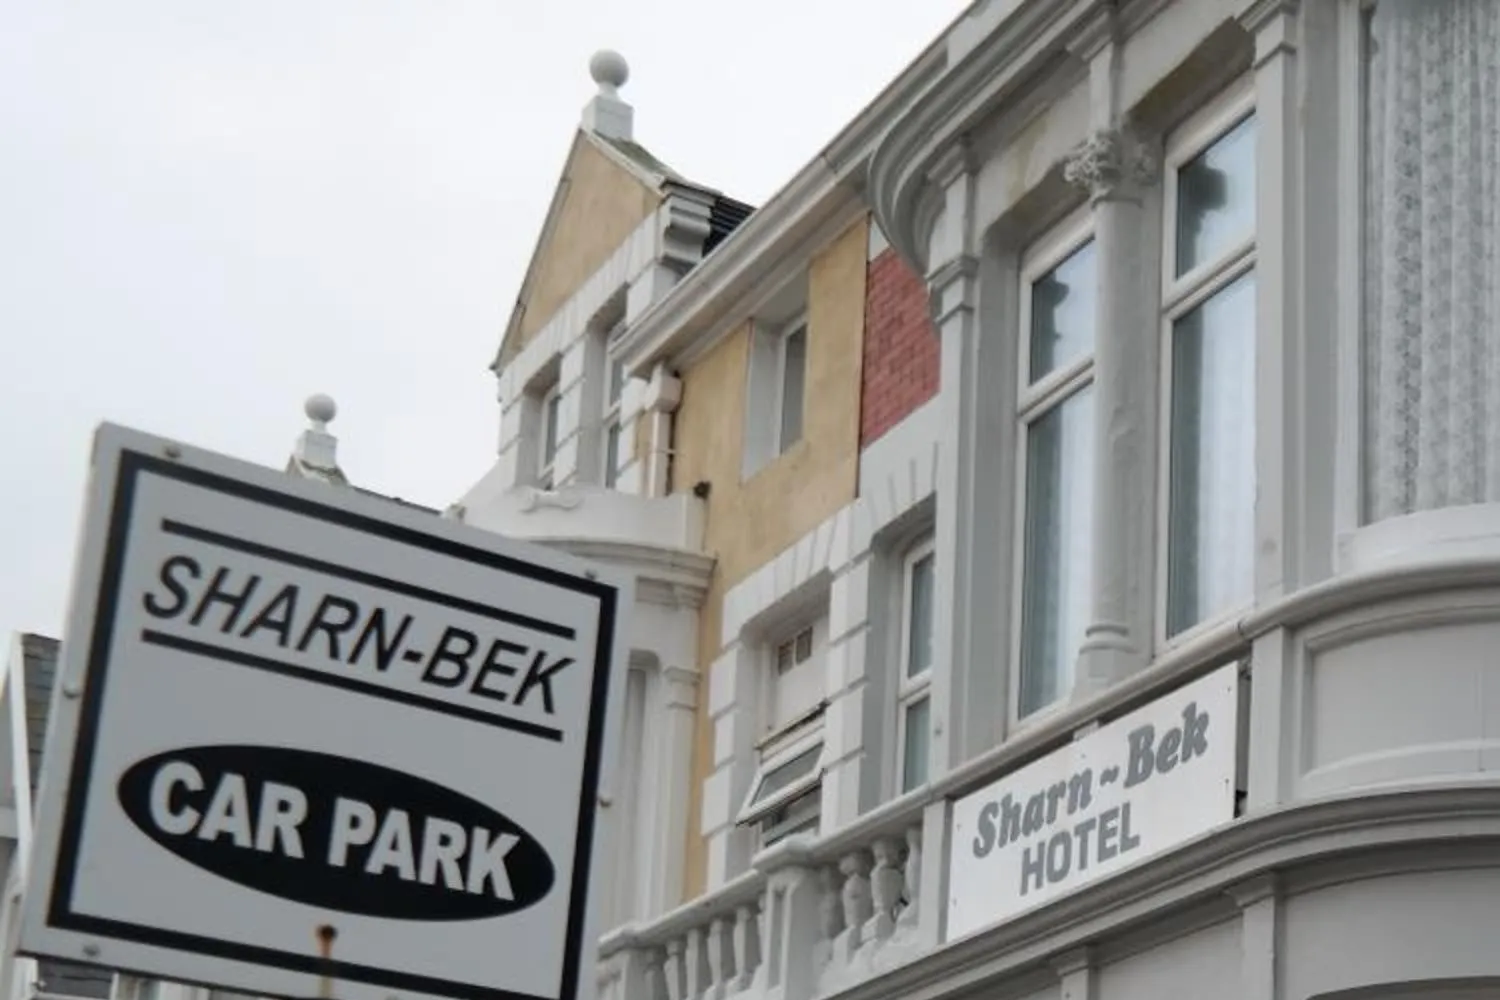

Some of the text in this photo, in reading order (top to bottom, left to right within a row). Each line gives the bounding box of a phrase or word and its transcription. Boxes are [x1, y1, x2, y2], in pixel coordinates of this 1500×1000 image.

[142, 555, 576, 714] SHARN-BEK
[149, 760, 521, 901] CAR PARK
[1019, 802, 1140, 896] HOTEL
